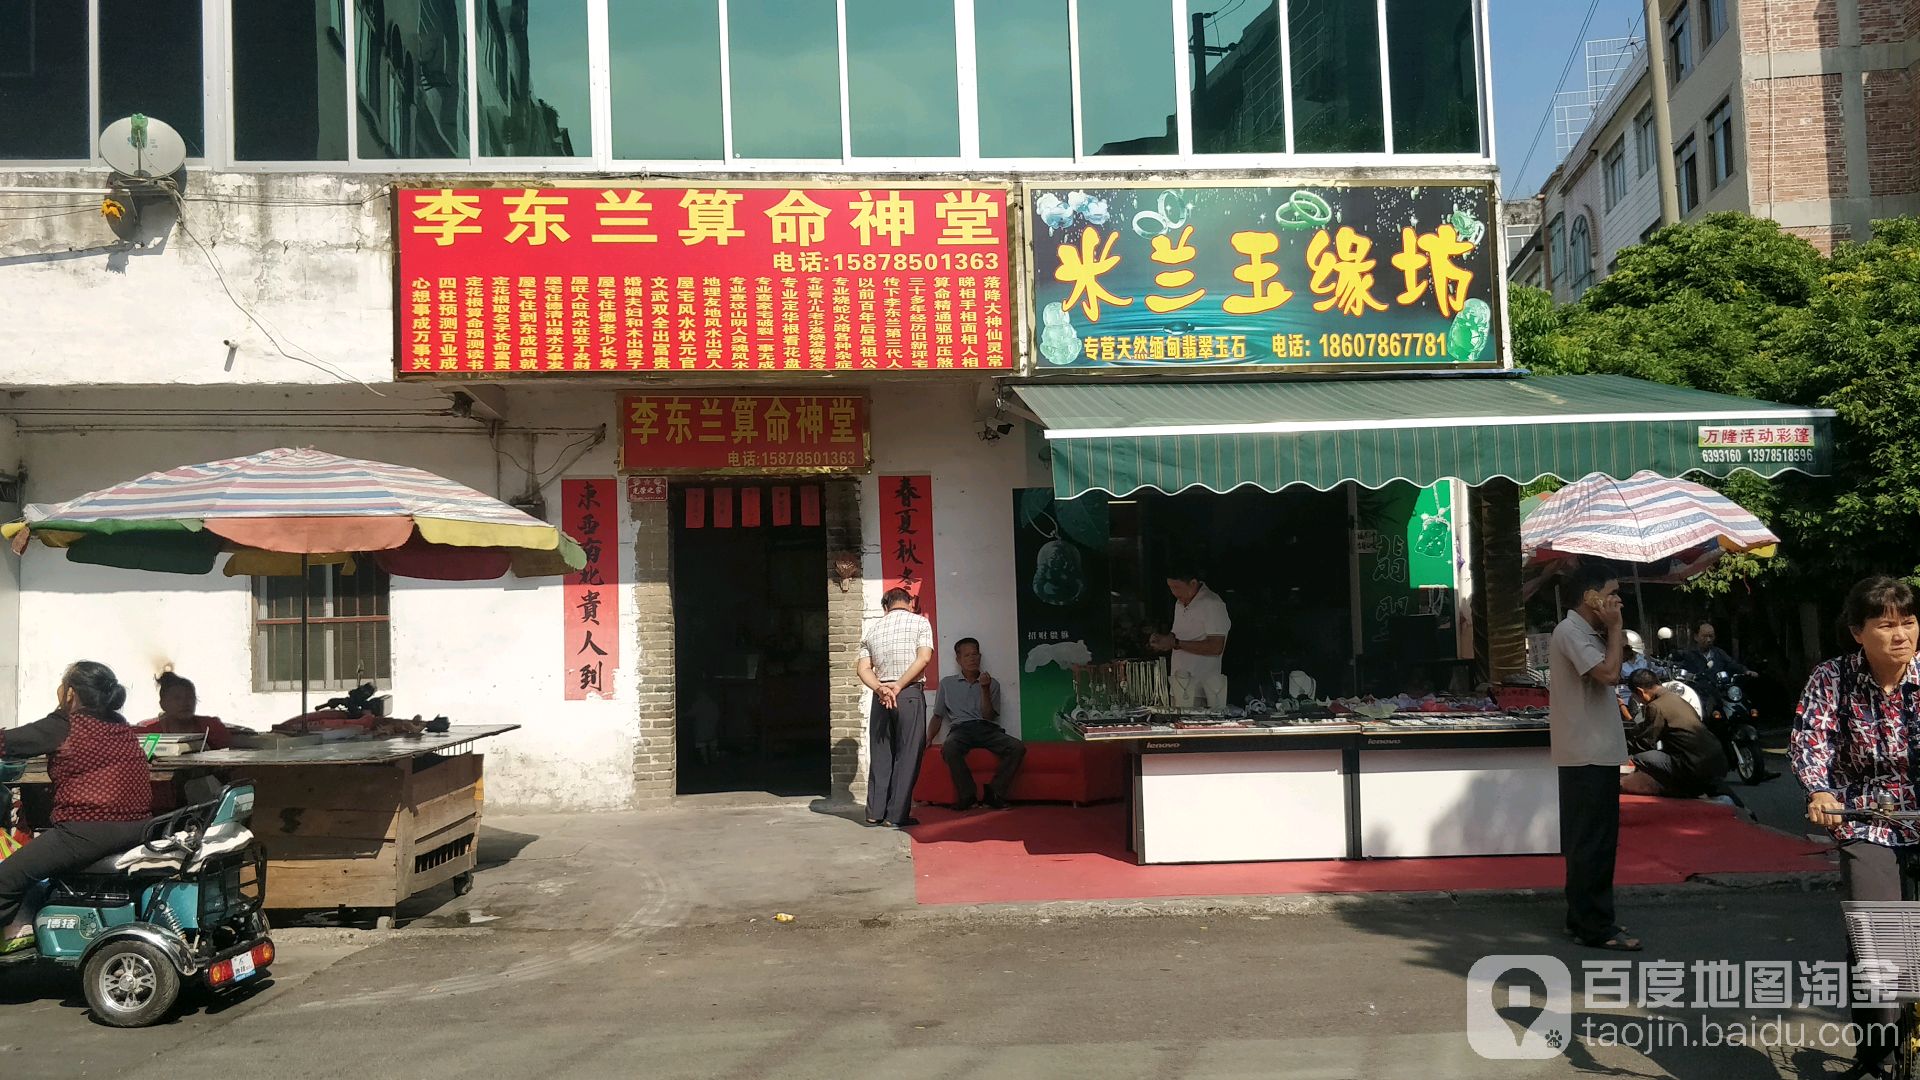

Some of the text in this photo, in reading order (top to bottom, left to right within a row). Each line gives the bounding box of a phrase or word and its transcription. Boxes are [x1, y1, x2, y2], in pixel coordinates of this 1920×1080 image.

[413, 189, 1000, 246] 李东兰算命神堂
[773, 251, 999, 273] 电话:15878501363
[1054, 223, 1477, 322] 米兰玉缘坊
[411, 277, 432, 368] 心想事成万事兴
[438, 277, 459, 368] 四柱预测百业成
[465, 276, 485, 368] 定花根算命预测读书
[491, 276, 512, 368] 定花根取名字长命富贵
[518, 276, 538, 368] 屋宅住到东成西就
[597, 276, 618, 368] 屋宅住德老少长寿
[623, 276, 644, 368] 婚姻夫妇和木出贵子
[650, 276, 671, 368] 文武双全出富贵
[676, 276, 697, 368] 屋宅风水状元官
[780, 276, 801, 368] 专业定华根看花盘
[857, 277, 878, 368] 以前百年后是祖公
[882, 276, 903, 368] 传下李东兰第三代人
[958, 276, 979, 367] 睇相手相面相人相
[983, 275, 1004, 366] 落降大神仙灵常
[1083, 336, 1246, 361] 专营天然缅甸翡翠玉石
[630, 396, 857, 446] 李东兰算命神堂
[727, 451, 856, 467] 电话:15878501363
[1702, 448, 1813, 462] 6393160 13978518596
